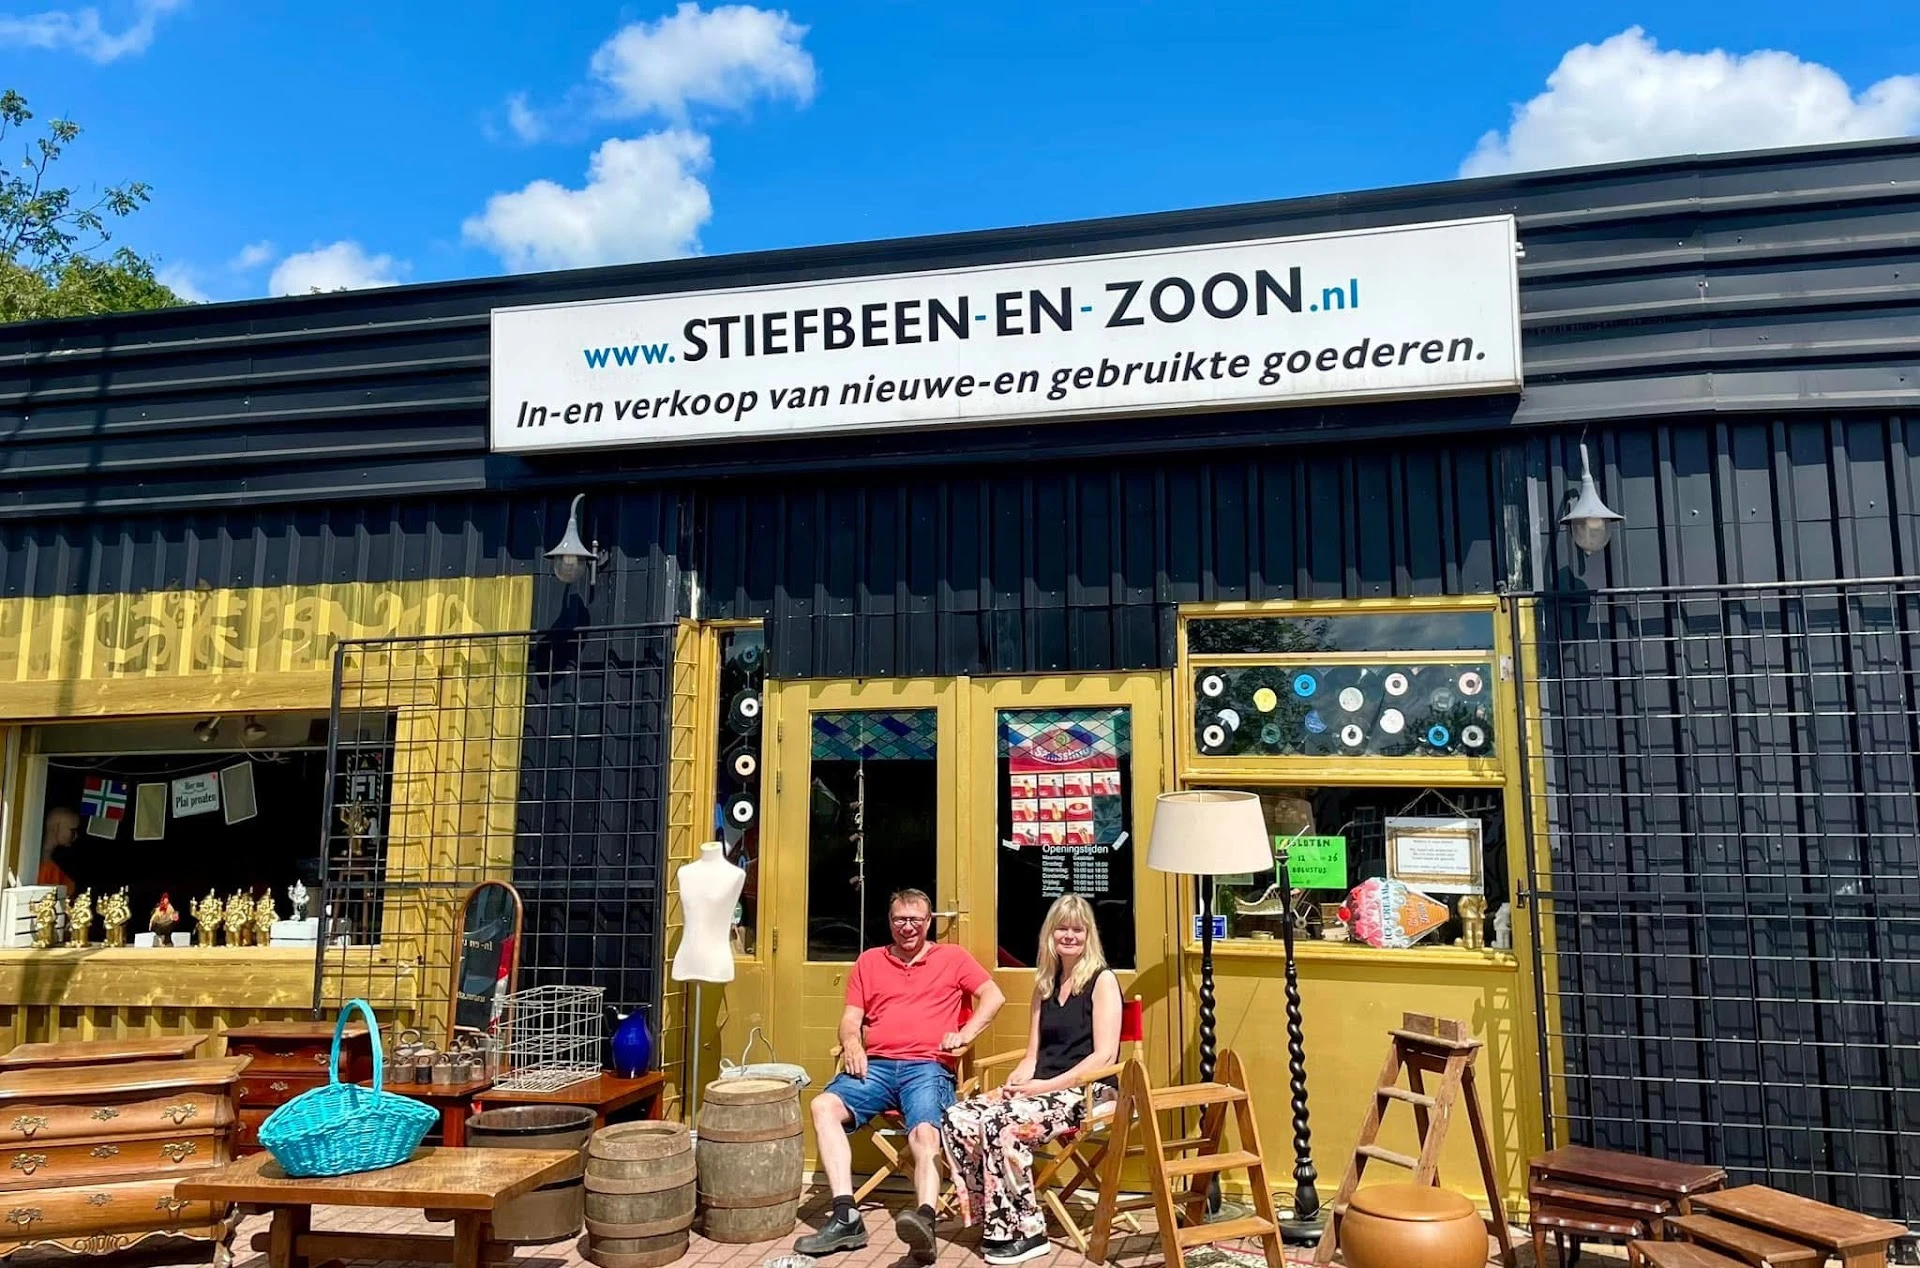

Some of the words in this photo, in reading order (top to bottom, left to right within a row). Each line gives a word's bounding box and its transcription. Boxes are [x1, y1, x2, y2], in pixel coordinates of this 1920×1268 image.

[517, 402, 603, 428] In-en
[614, 389, 757, 422] verkoop
[770, 388, 830, 409] van
[840, 374, 1040, 405] nieuwe-en
[1047, 351, 1250, 401] gebruikte
[1258, 338, 1486, 386] goederen.
[351, 775, 375, 800] F1
[1042, 844, 1109, 855] Openingstijden
